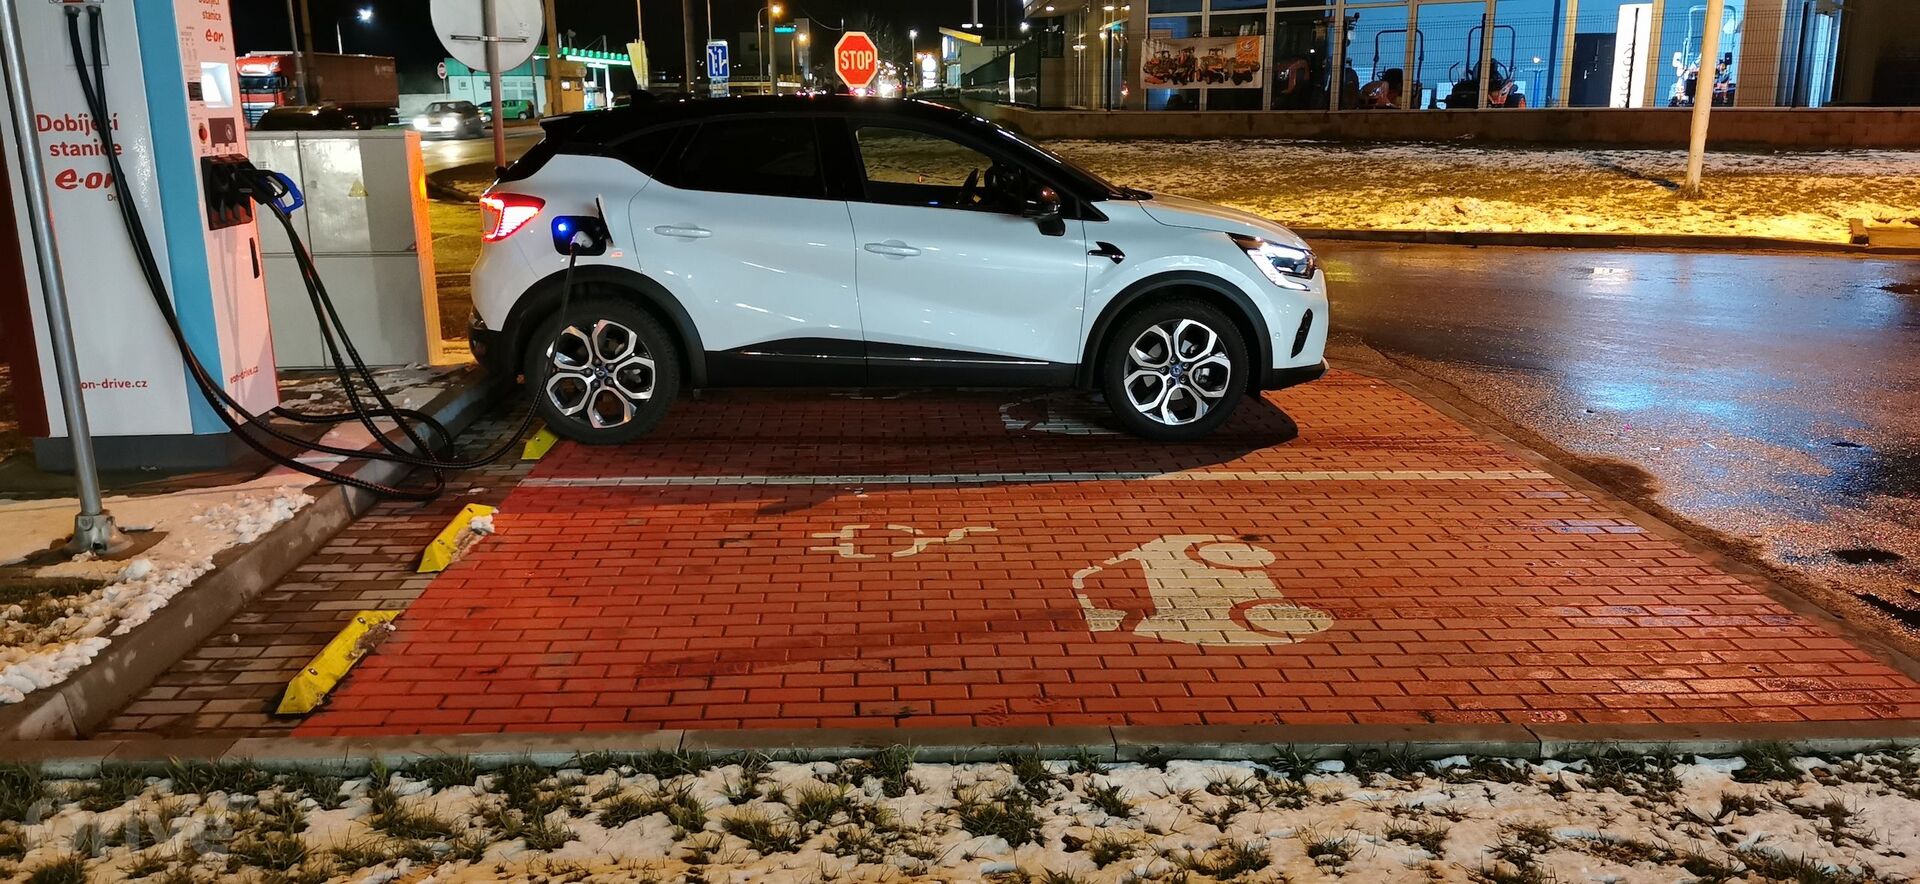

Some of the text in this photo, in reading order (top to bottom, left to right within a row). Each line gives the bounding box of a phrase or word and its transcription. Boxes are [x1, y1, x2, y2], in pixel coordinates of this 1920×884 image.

[840, 50, 873, 70] STOP
[36, 112, 118, 136] Dobíjeí
[80, 378, 148, 390] on-drive.cz
